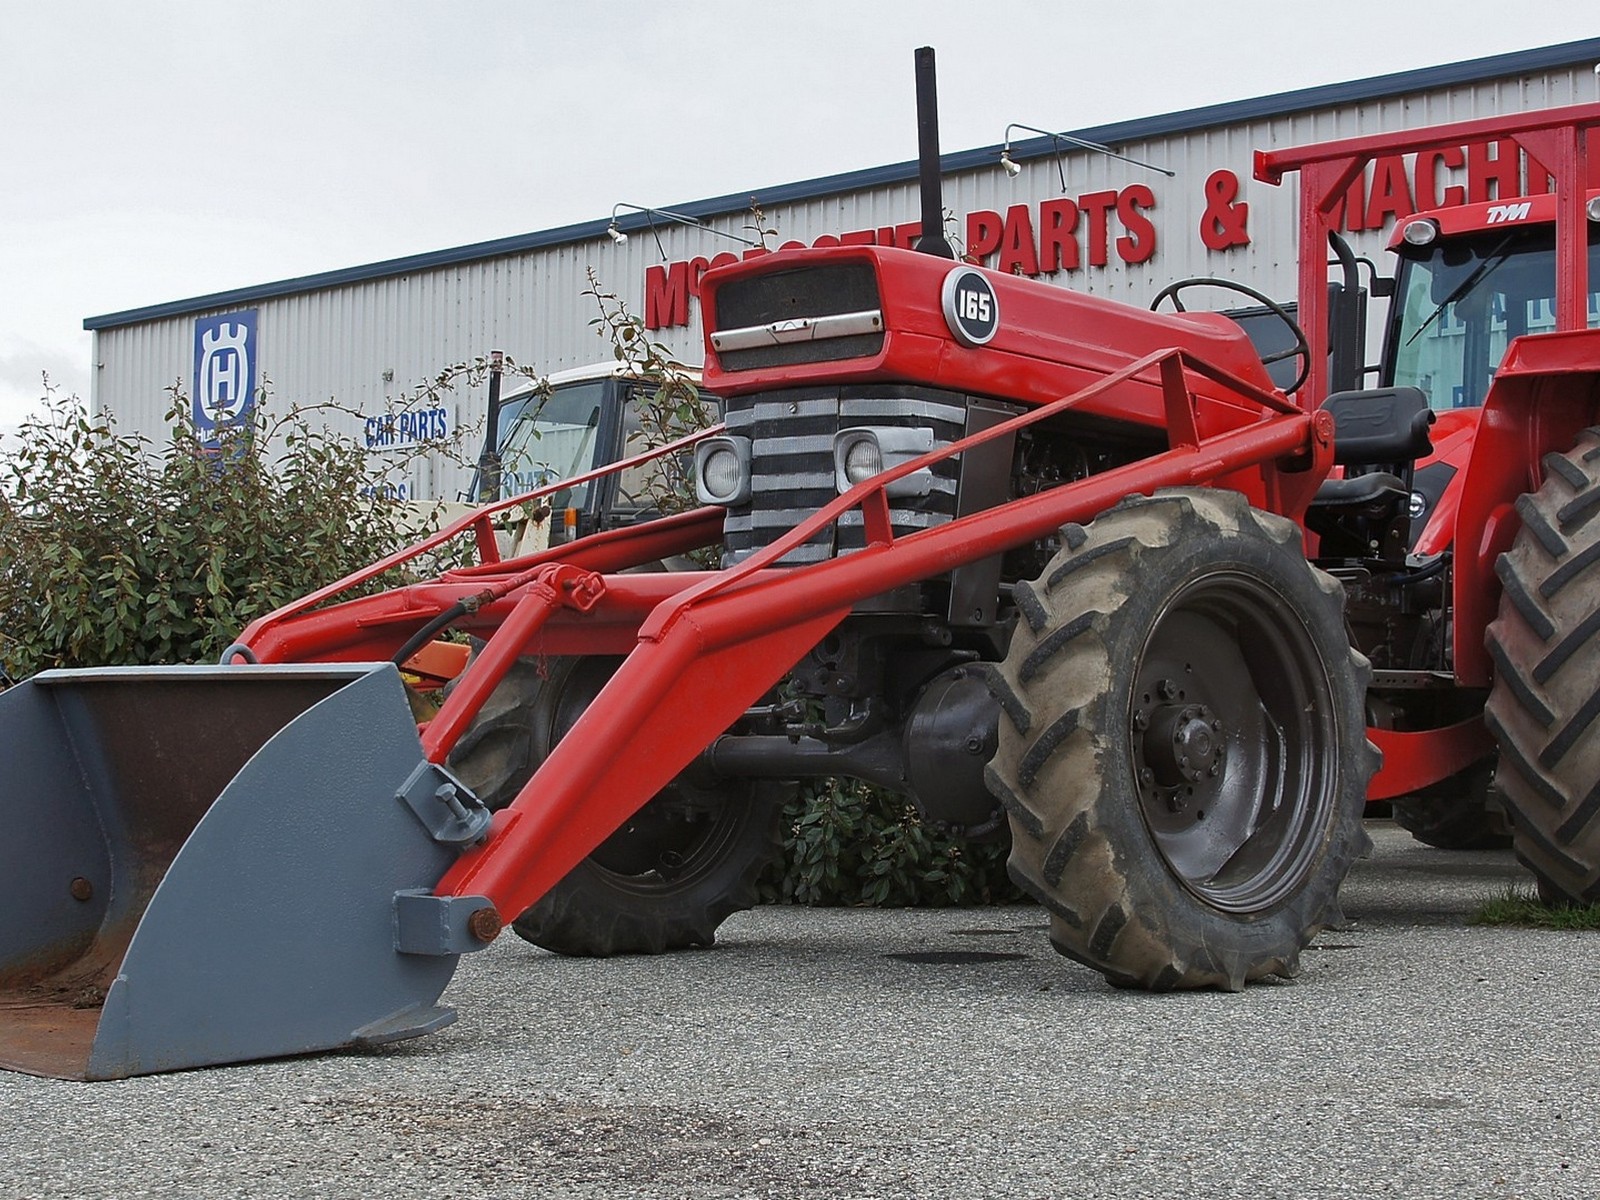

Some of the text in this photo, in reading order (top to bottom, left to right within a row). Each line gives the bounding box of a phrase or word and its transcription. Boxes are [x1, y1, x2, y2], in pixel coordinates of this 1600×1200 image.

[966, 183, 1156, 275] PARTS
[1200, 168, 1251, 251] &
[1486, 202, 1532, 224] TYM
[959, 289, 991, 322] 165
[365, 408, 447, 448] CAR PARTS
